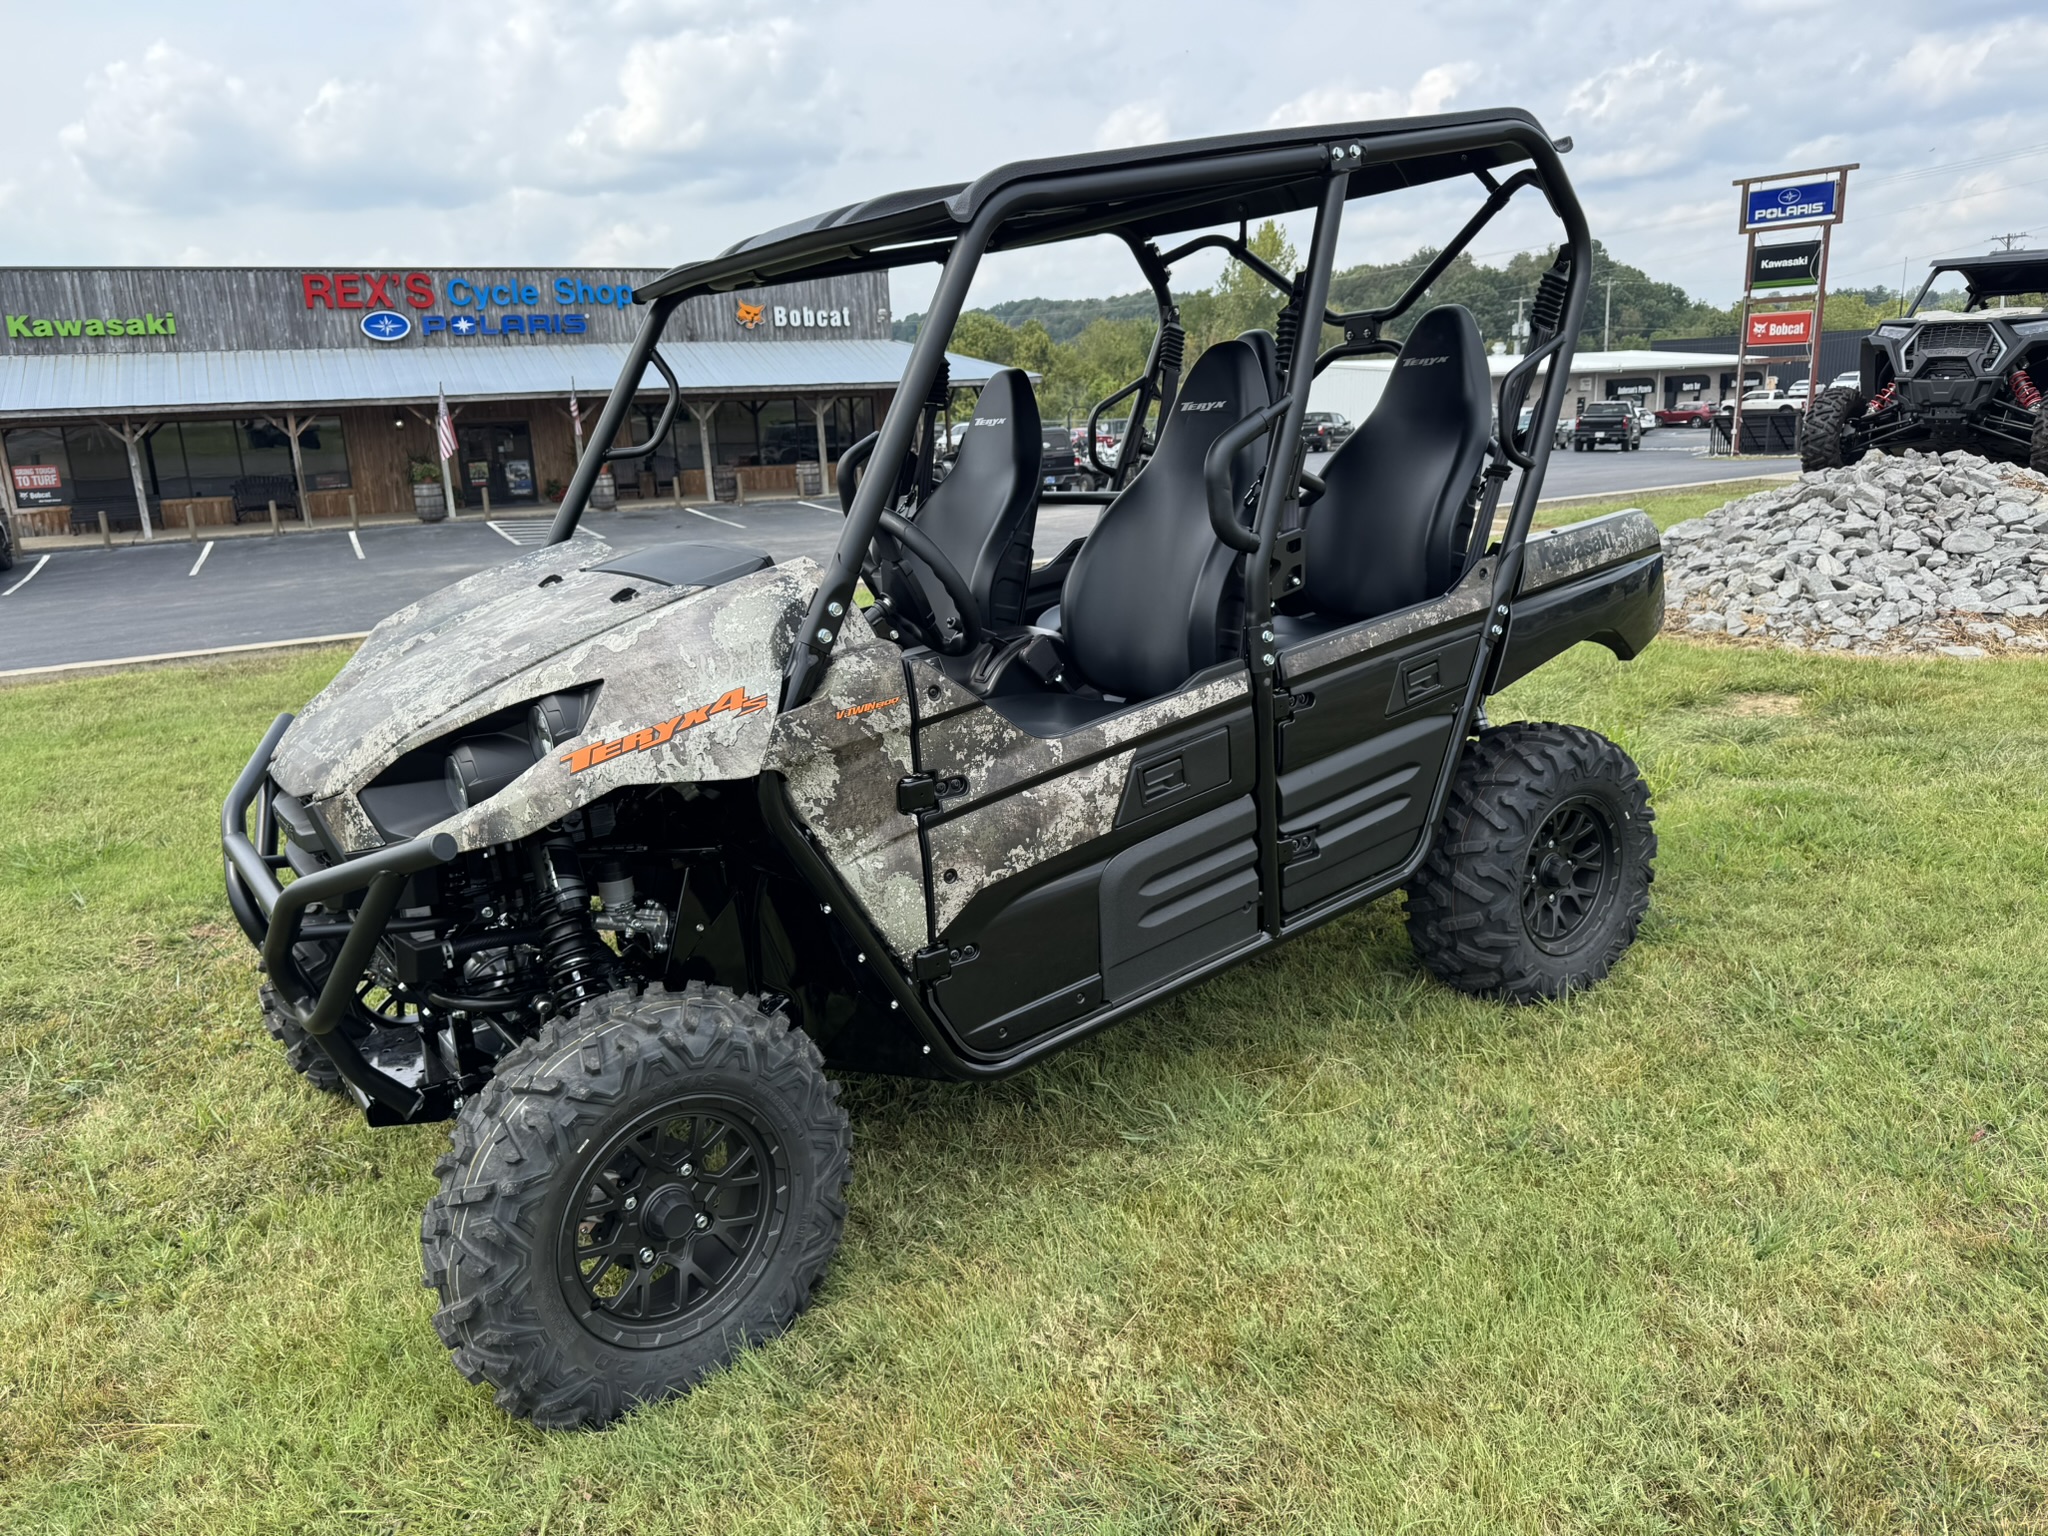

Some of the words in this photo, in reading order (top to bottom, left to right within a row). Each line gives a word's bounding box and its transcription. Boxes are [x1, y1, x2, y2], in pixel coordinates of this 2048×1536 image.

[1754, 202, 1824, 221] POLARIS
[1760, 256, 1809, 269] Kawasaki
[301, 272, 436, 310] REX'S
[446, 277, 540, 311] Cycle
[553, 277, 633, 310] Shop
[5, 311, 177, 338] Kawasaki
[421, 313, 588, 336] POLARIS
[773, 306, 851, 327] Bobcat
[1768, 322, 1804, 336] Bobcat
[1180, 400, 1228, 412] TERYX
[974, 417, 1007, 427] TERYX
[16, 475, 30, 487] TO
[31, 474, 58, 486] TURF
[1537, 527, 1614, 570] Kawasaki
